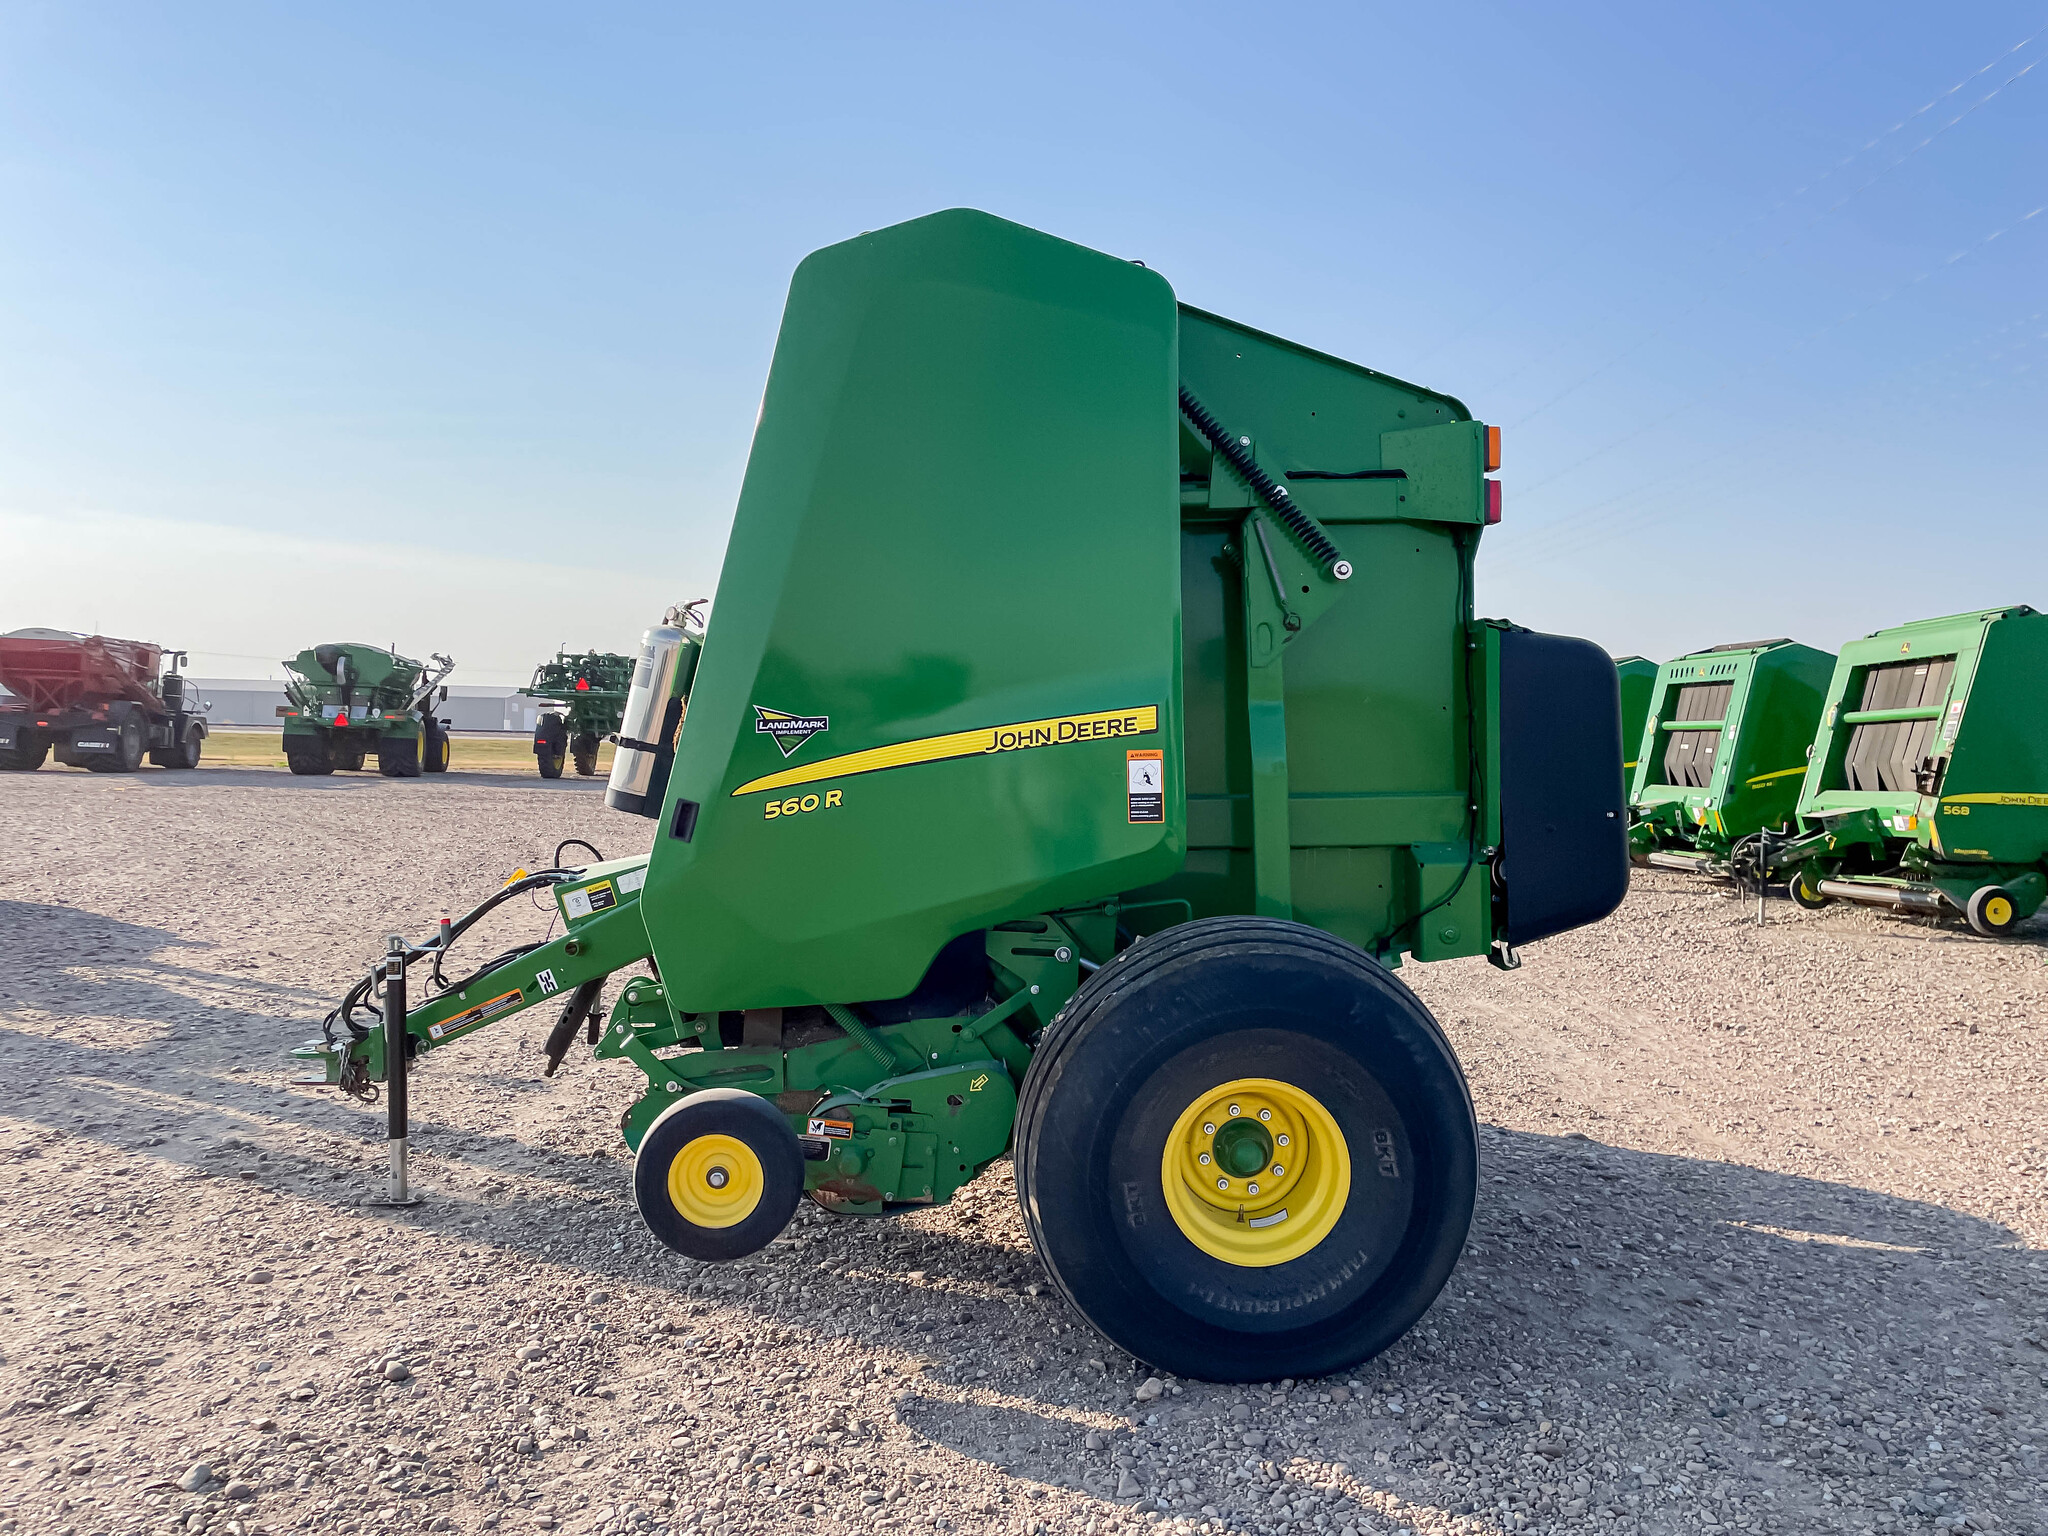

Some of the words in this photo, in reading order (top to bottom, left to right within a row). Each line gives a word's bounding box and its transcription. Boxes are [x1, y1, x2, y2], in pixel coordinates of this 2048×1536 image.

[985, 727, 1051, 751] JOHN
[1058, 717, 1138, 741] DEERE
[764, 794, 820, 820] 560
[824, 789, 843, 809] R
[1943, 805, 1970, 816] 568
[2000, 796, 2026, 804] JOHN
[1373, 1129, 1399, 1177] BKT
